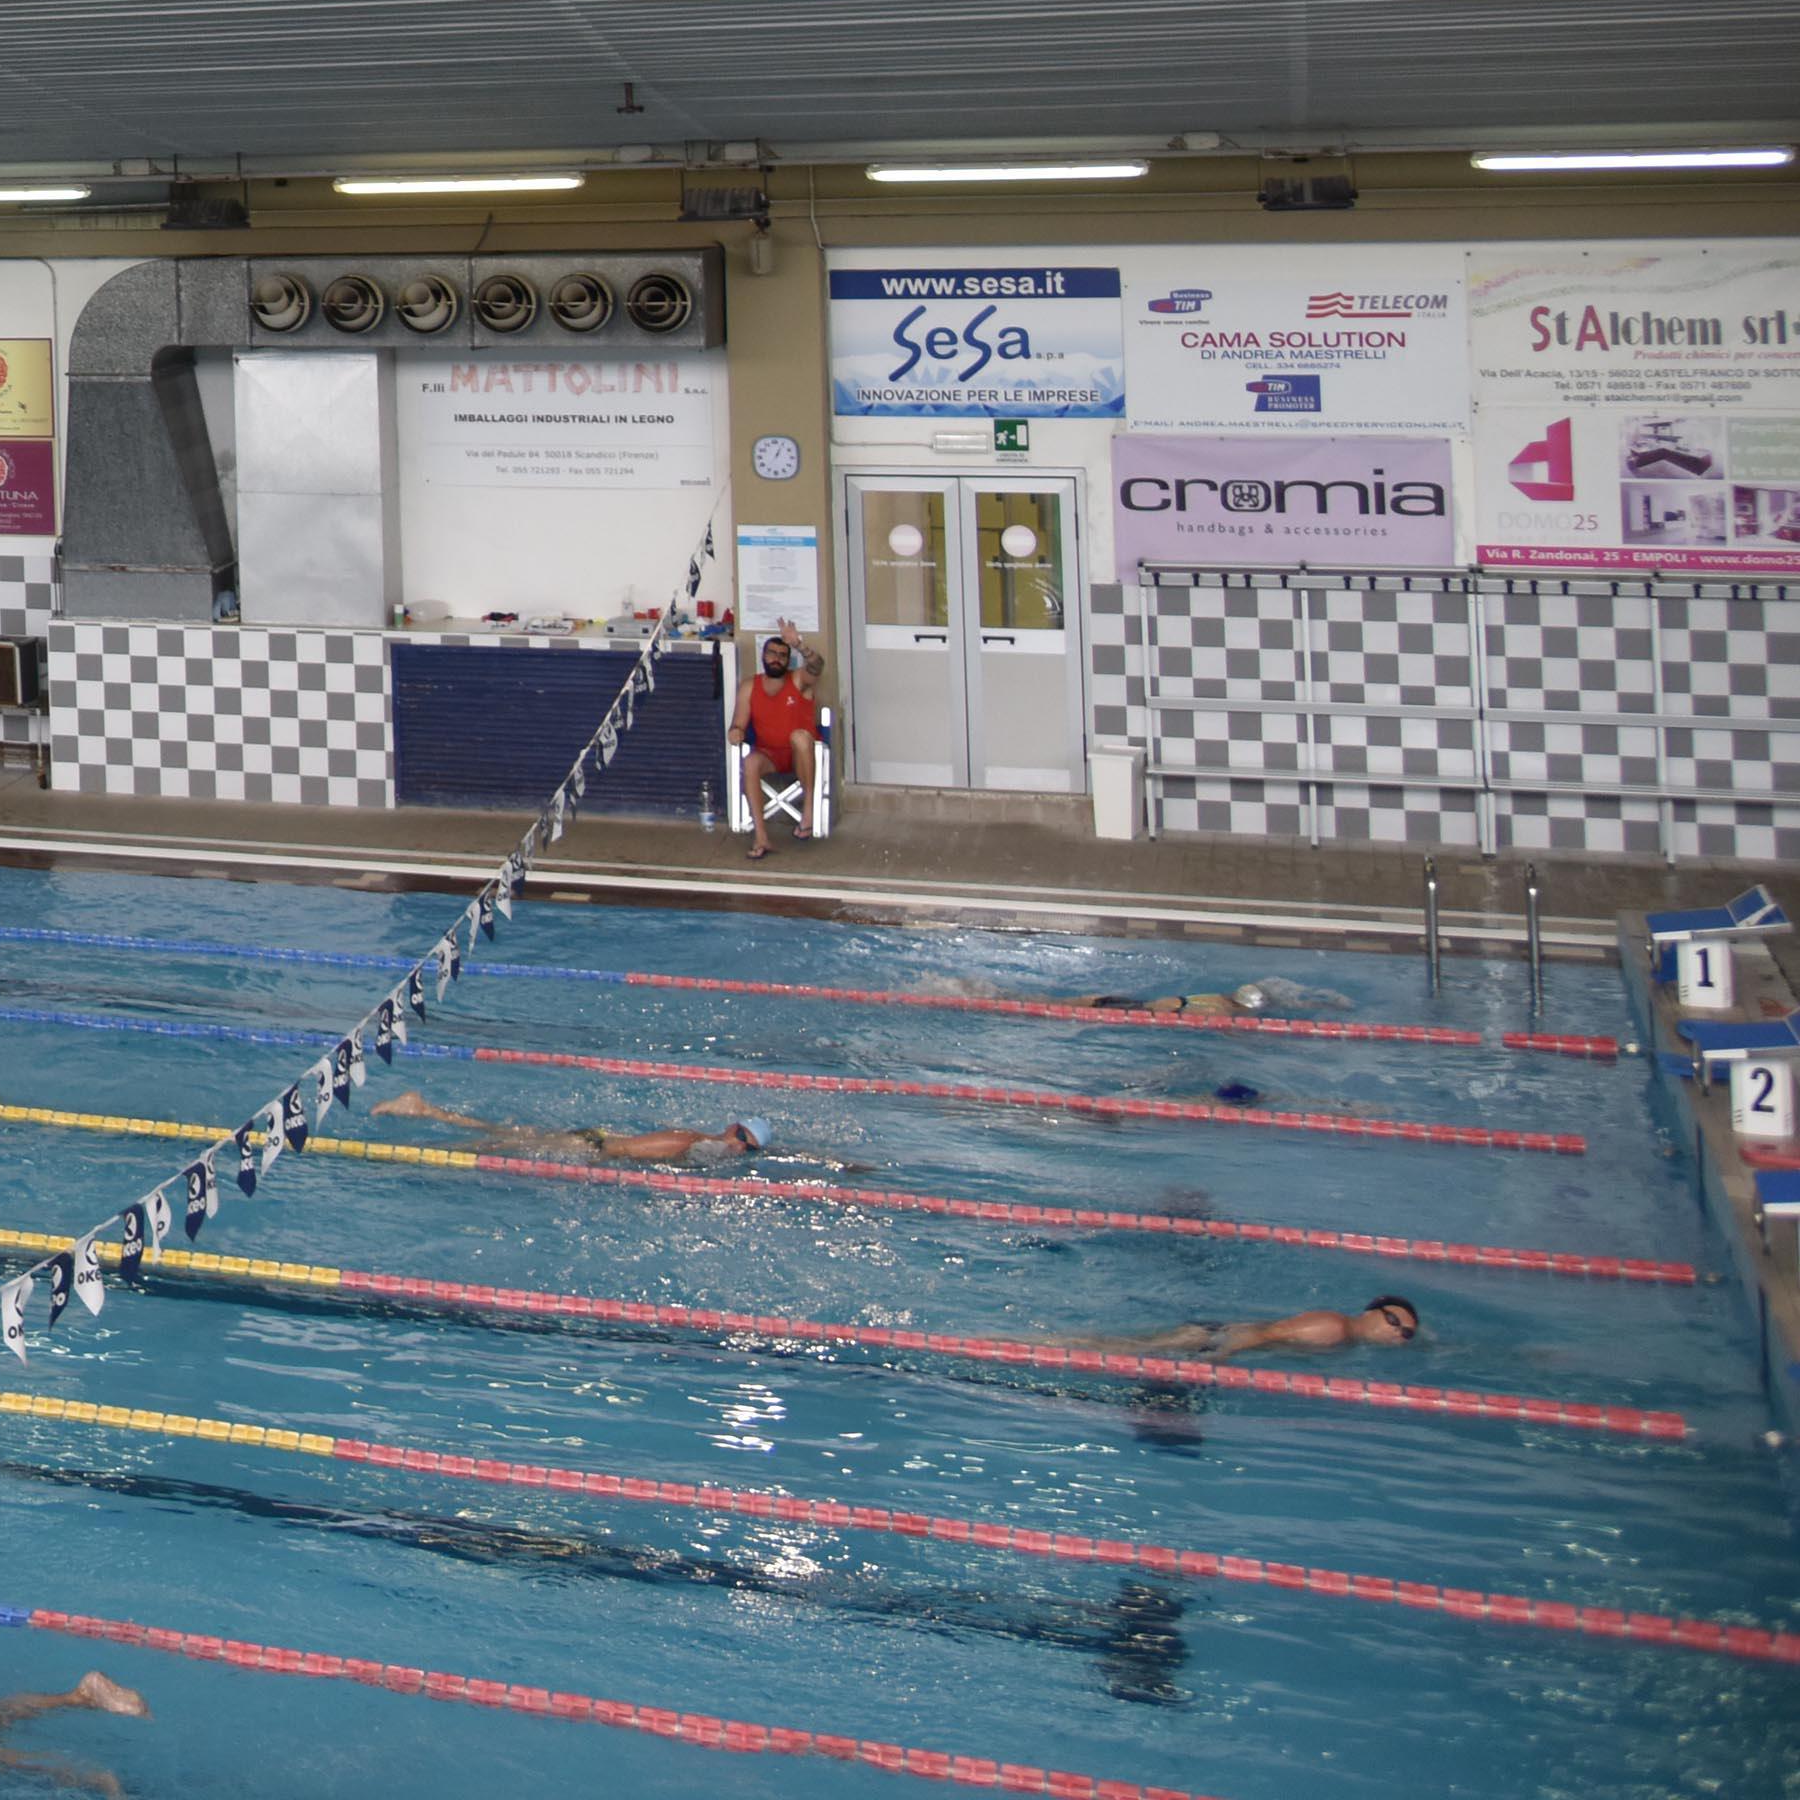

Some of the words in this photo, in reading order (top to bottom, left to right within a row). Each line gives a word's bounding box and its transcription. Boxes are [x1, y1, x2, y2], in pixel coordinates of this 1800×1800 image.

[881, 271, 1065, 295] www.sesa.it
[1173, 300, 1196, 312] TIM
[1358, 294, 1448, 310] TELECOM
[1417, 311, 1447, 319] ITALIA
[1530, 305, 1722, 352] StAlchem
[1742, 310, 1787, 345] srl
[1181, 331, 1261, 348] CAMA
[1269, 331, 1407, 348] SOLUTION
[1201, 350, 1216, 360] DI
[1220, 350, 1284, 360] ANDREA
[1289, 350, 1386, 360] MAESTRELLI
[450, 362, 679, 396] MATTOLINI
[1480, 369, 1497, 378] Via
[1569, 369, 1598, 378] 13/15
[1644, 369, 1745, 378] CASTELFRANCO
[1268, 382, 1286, 392] TIM
[1576, 381, 1601, 390] 0571
[1656, 381, 1677, 390] Fax
[857, 389, 962, 401] INNOVAZIONE
[967, 389, 999, 401] PER
[1004, 390, 1023, 401] LE
[1028, 389, 1099, 402] IMPRESE
[454, 413, 528, 424] IMBALLAGGI
[532, 414, 610, 424] INDUSTRIALI
[615, 414, 628, 424] IN
[632, 414, 675, 424] LEGNO
[465, 449, 479, 458] Via
[575, 450, 616, 460] Scandicci
[618, 451, 659, 462] (Firenze)
[1120, 468, 1447, 517] cromia
[1176, 521, 1254, 536] handbags
[1264, 524, 1274, 535] &
[1284, 526, 1388, 537] accessories
[1485, 549, 1508, 559] Via
[1512, 550, 1525, 560] R.
[1529, 550, 1599, 562] Zandonai,
[1603, 551, 1620, 561] 25
[1633, 552, 1687, 562] EMPOLI
[1696, 947, 1715, 989] 1
[1750, 1066, 1775, 1113] 2
